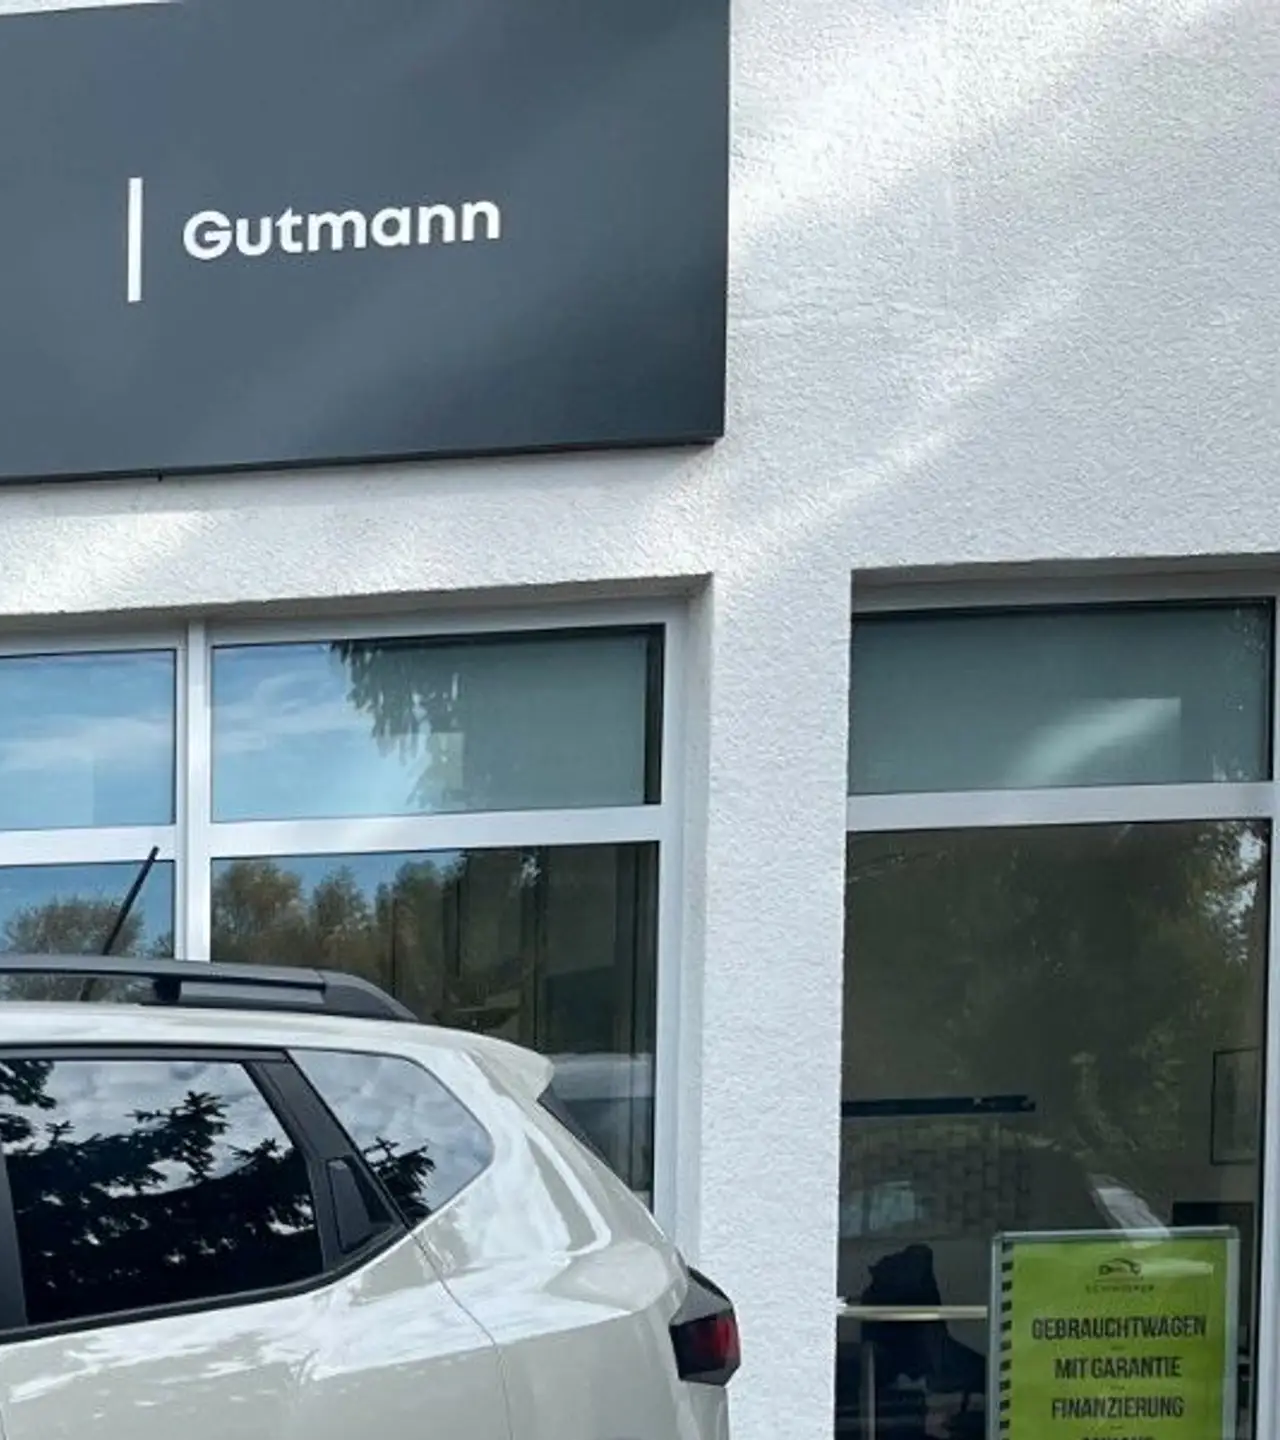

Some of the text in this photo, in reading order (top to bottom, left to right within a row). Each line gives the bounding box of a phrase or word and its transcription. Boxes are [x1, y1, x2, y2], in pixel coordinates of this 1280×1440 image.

[183, 199, 501, 260] Gutmann
[1032, 1315, 1207, 1341] GEBRAUCHTWAGEN
[1054, 1356, 1183, 1379] MIT GARANTIE
[1051, 1396, 1185, 1420] FINANZIERUNG
